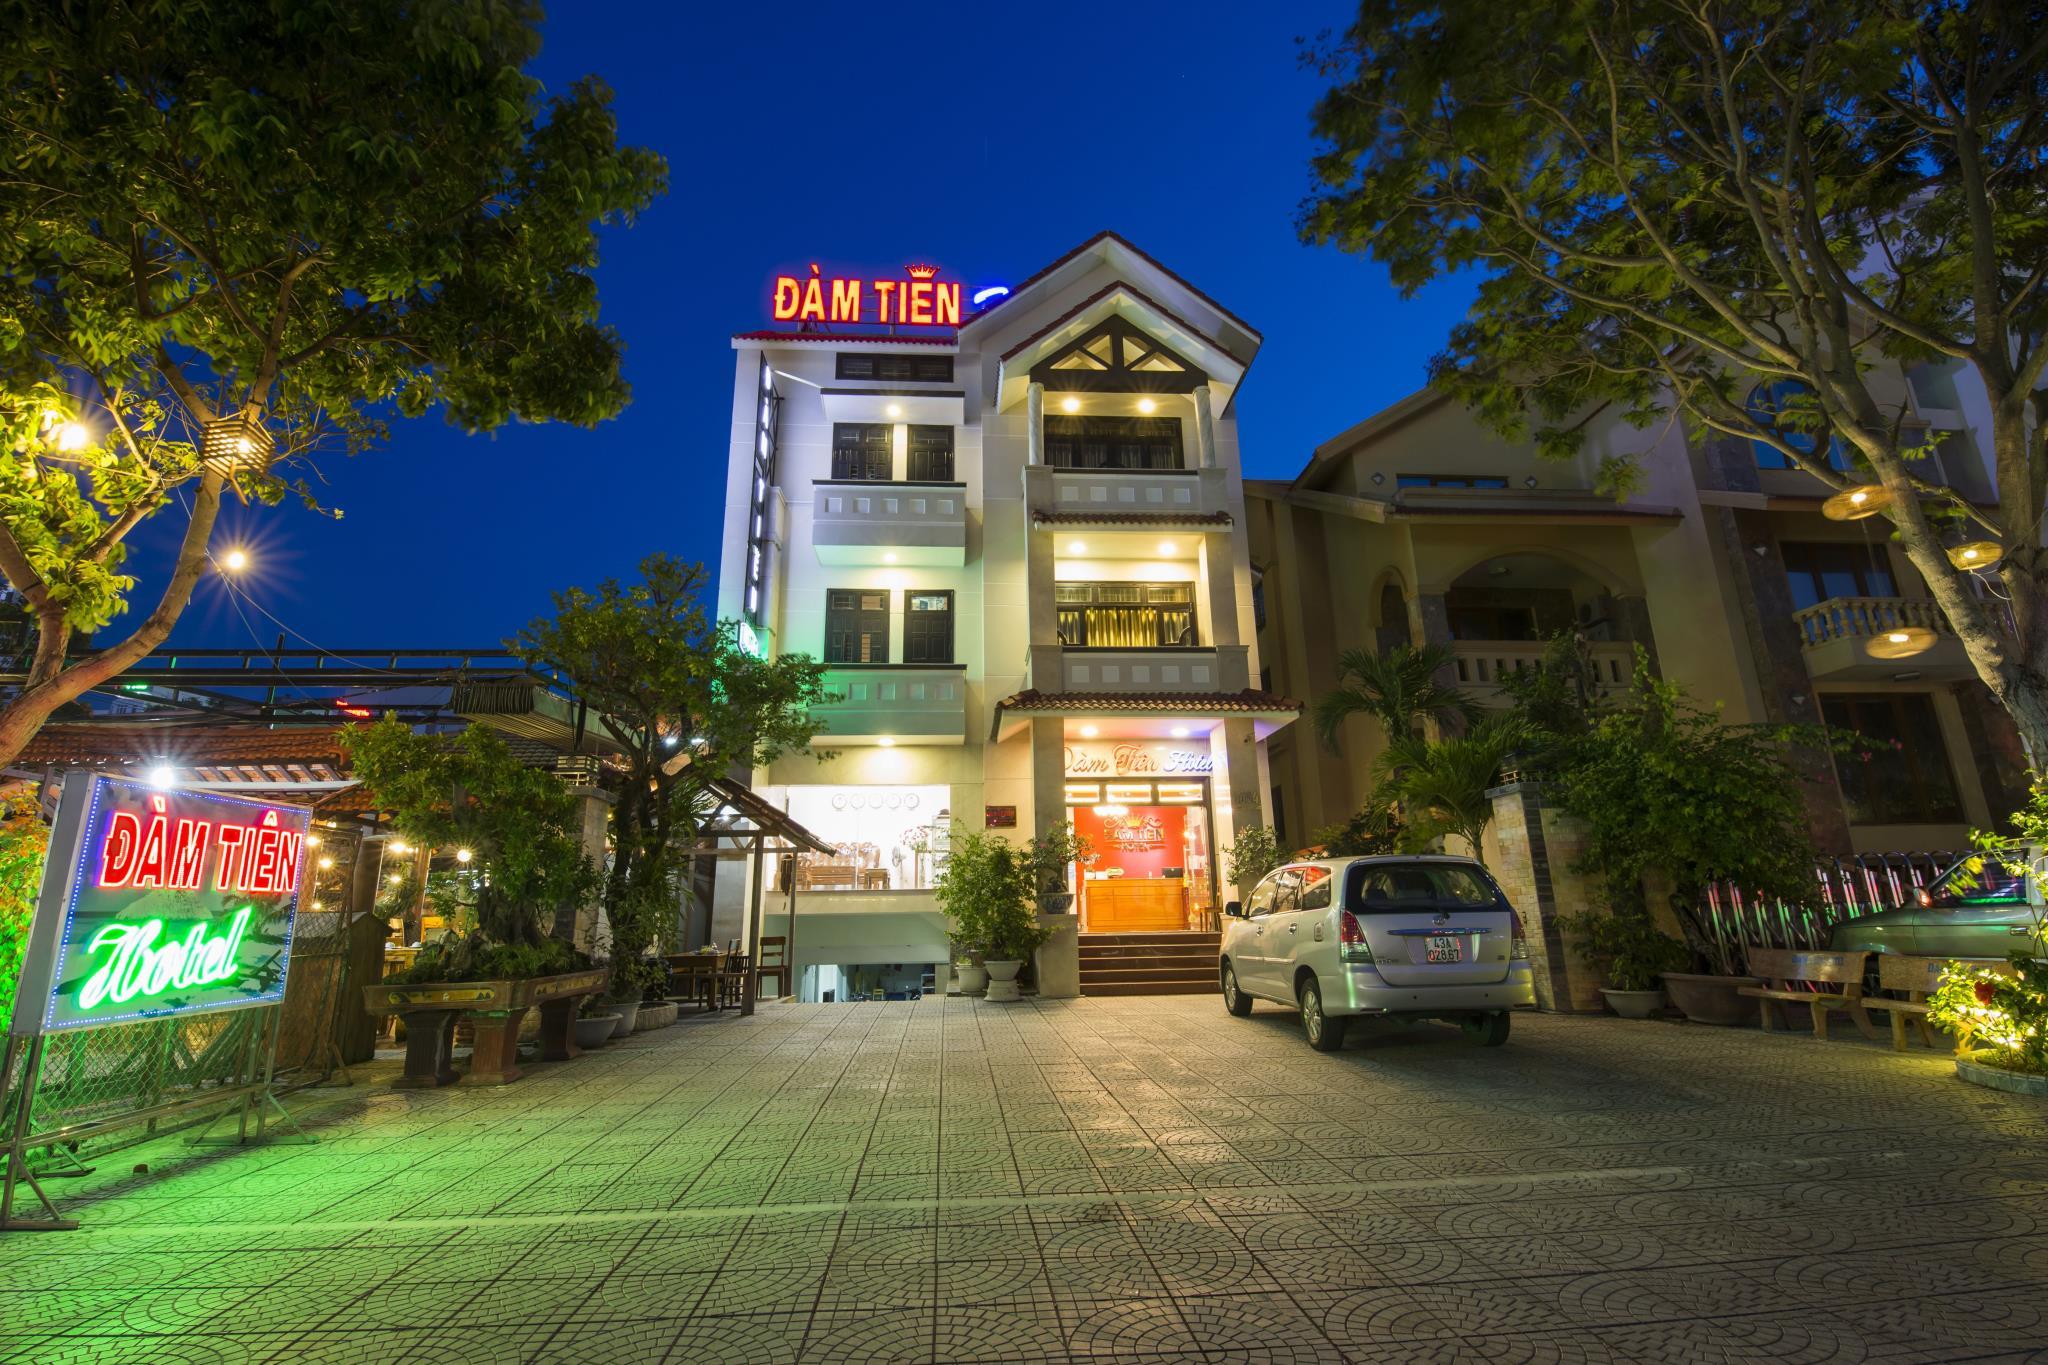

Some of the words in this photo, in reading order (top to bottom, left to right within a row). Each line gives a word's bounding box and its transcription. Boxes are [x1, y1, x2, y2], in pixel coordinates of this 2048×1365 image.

[773, 263, 861, 322] ĐÀM
[99, 795, 211, 889] ĐÀM
[216, 810, 303, 893] TIÊN
[79, 906, 253, 1010] Hotel
[1434, 937, 1452, 948] 43A
